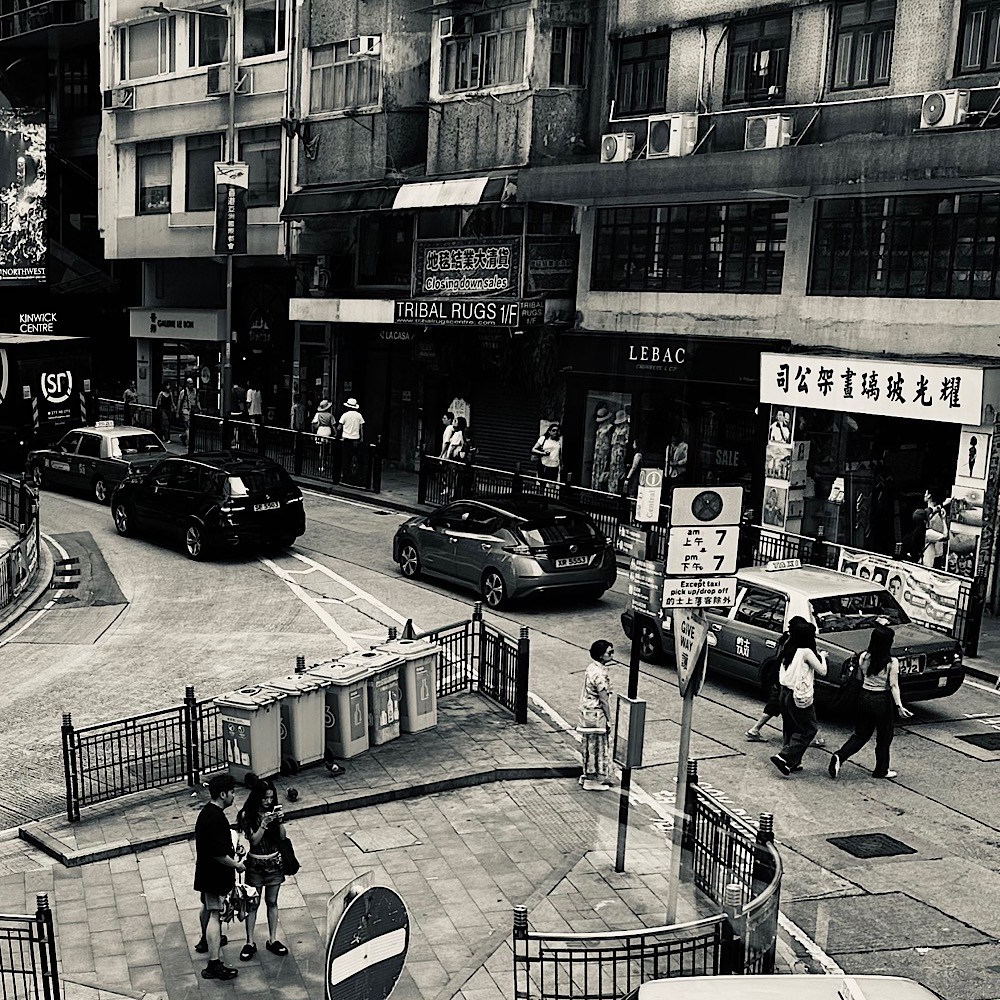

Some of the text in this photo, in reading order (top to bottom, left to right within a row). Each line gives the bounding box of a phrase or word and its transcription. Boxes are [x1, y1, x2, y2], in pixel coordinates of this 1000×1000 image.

[426, 248, 510, 272] 地毯結業大清貨
[2, 267, 46, 275] NORTHWEST
[20, 313, 57, 323] KINWICK
[396, 302, 518, 325] TRIBAL RUGS 1/F
[20, 323, 53, 333] CENTRE
[629, 346, 685, 364] LEBAC
[683, 537, 704, 546] 上午
[715, 530, 727, 546] 7
[685, 554, 725, 571] pm 7
[671, 588, 686, 596] pick
[688, 588, 717, 597] up/drop
[681, 621, 695, 640] GIVE
[680, 635, 693, 652] WAY
[736, 645, 750, 657] TAXI
